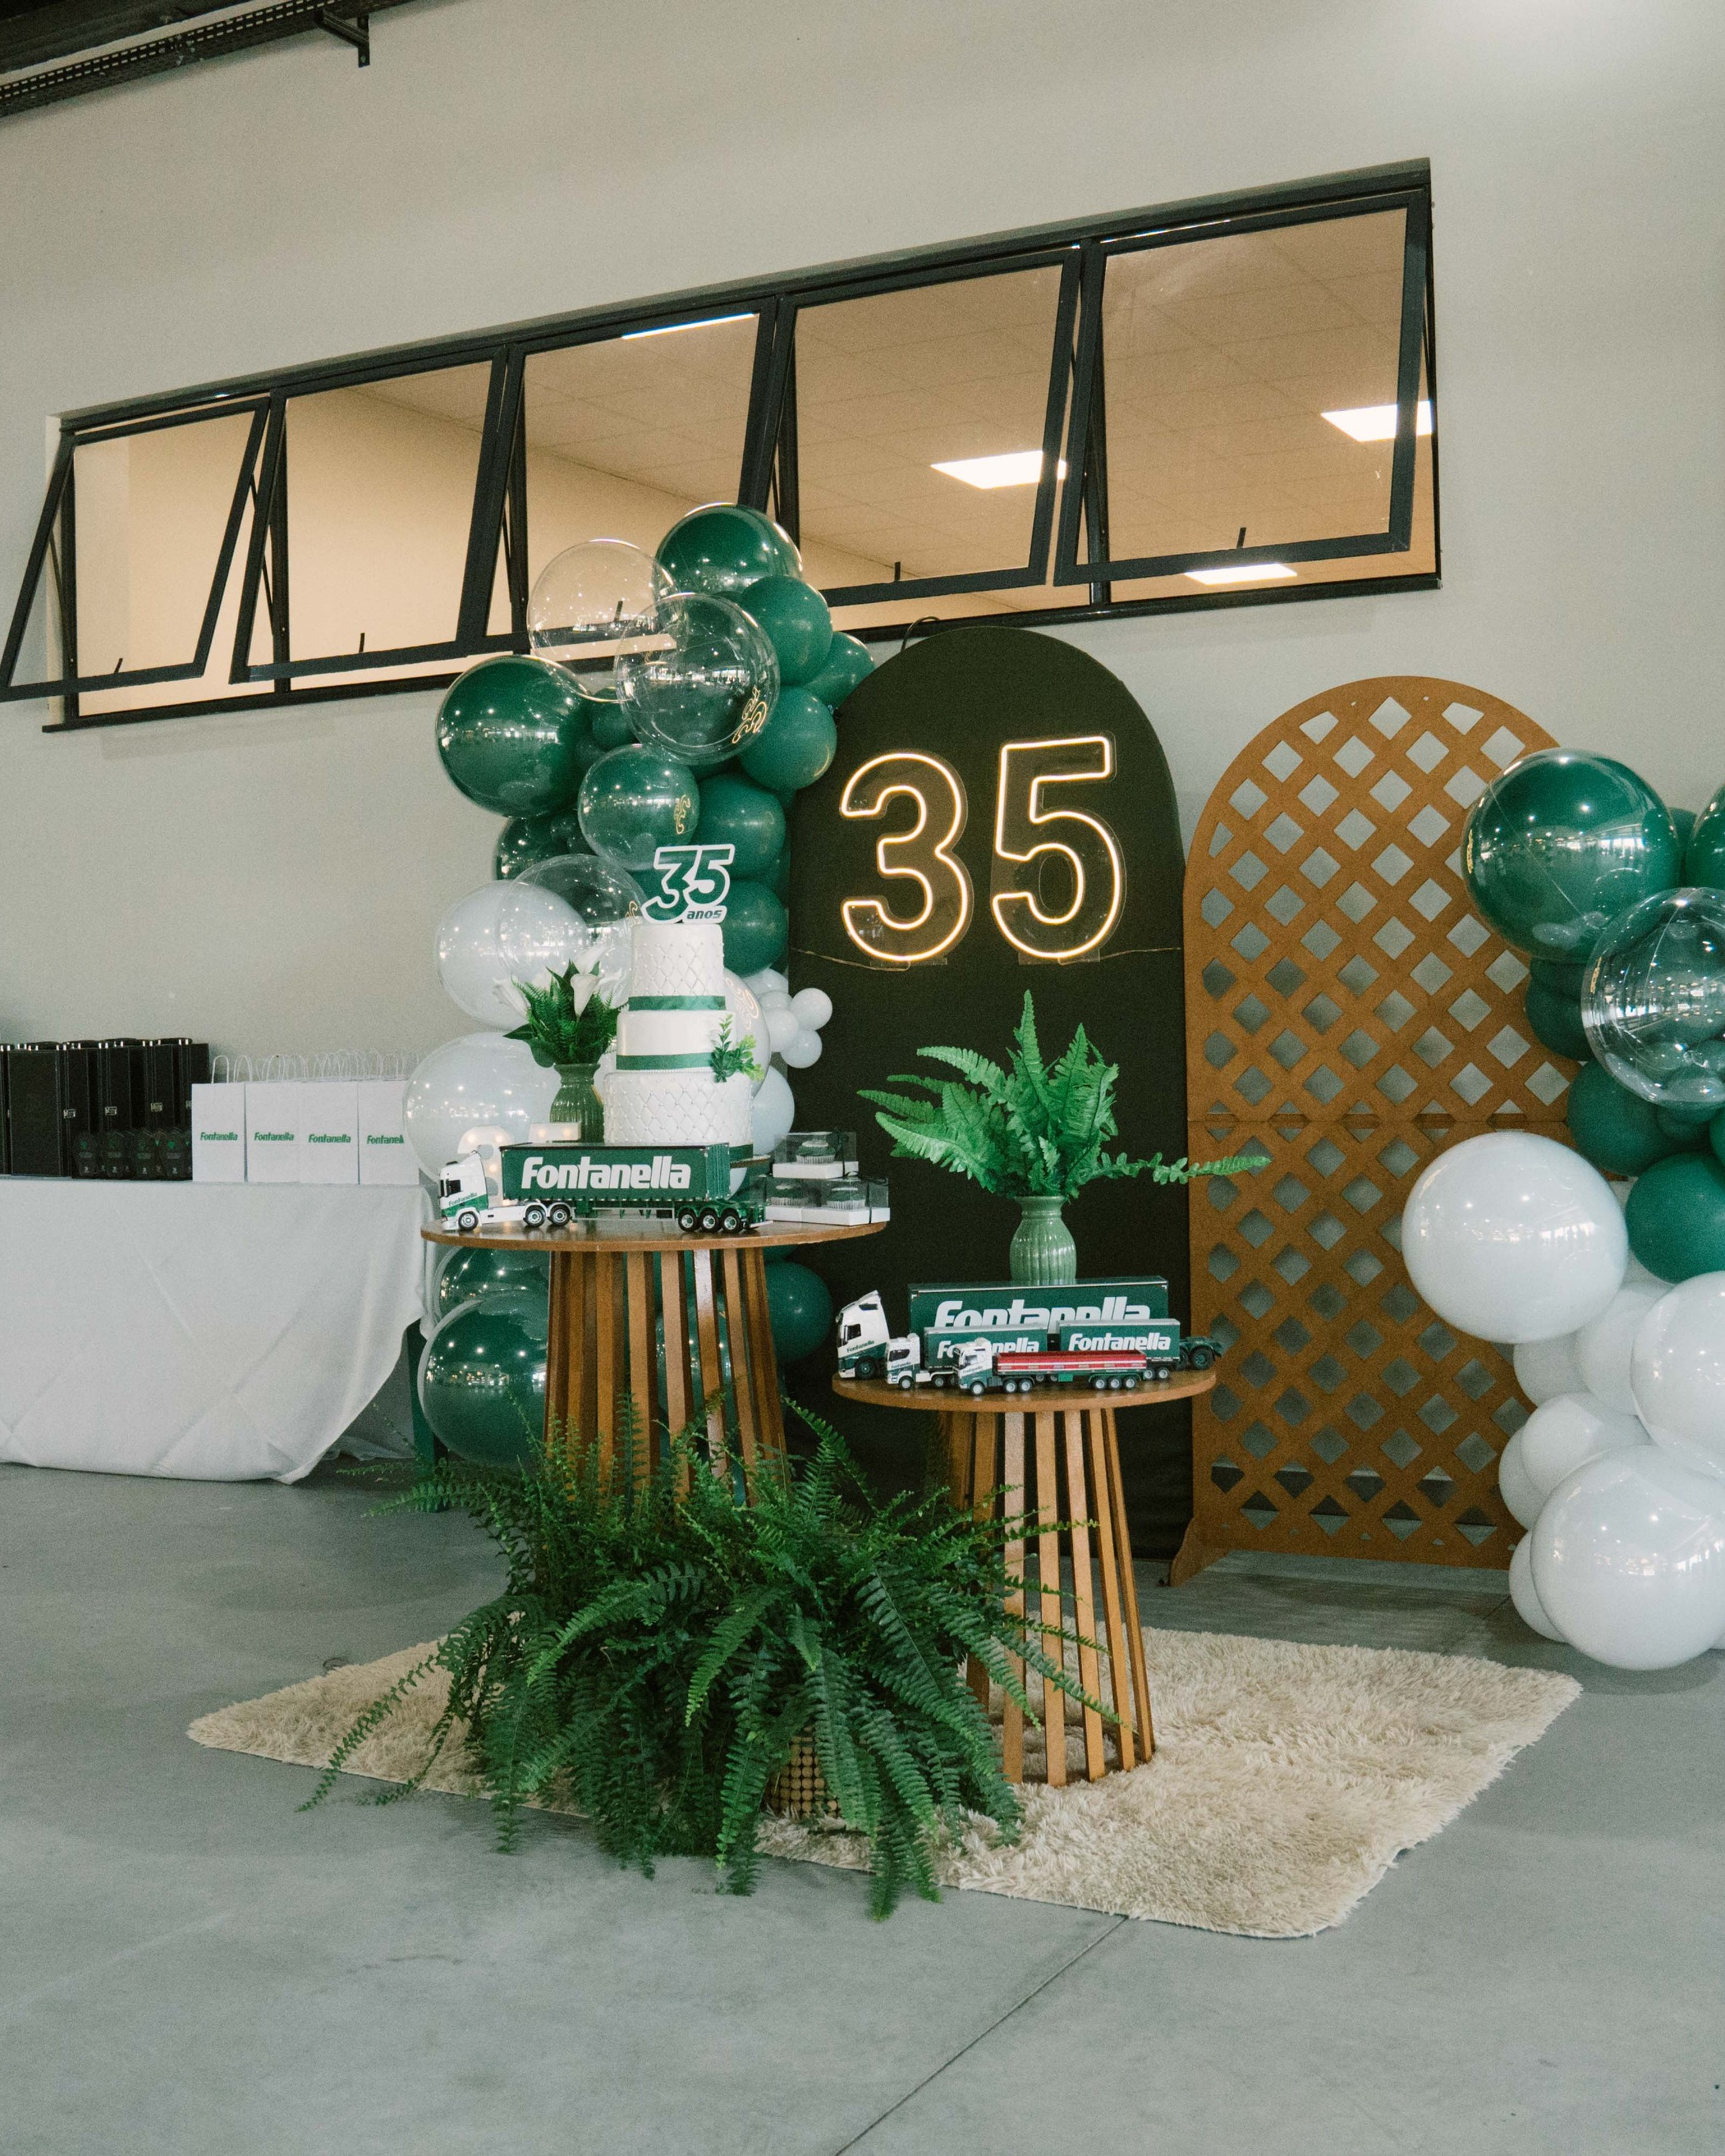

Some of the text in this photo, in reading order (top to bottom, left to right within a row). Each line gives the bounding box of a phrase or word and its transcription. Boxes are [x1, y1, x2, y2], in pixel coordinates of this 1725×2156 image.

[840, 734, 1122, 962] 35
[642, 844, 734, 923] 35
[687, 910, 723, 920] anos
[200, 1132, 238, 1141] Fontanella
[254, 1132, 294, 1141] Fontanella
[308, 1133, 351, 1143] Fontanella
[367, 1135, 404, 1144] Fontanell
[521, 1155, 691, 1188] Fontanella
[937, 1337, 1040, 1359] Fnella
[1069, 1332, 1171, 1351] Fontanella
